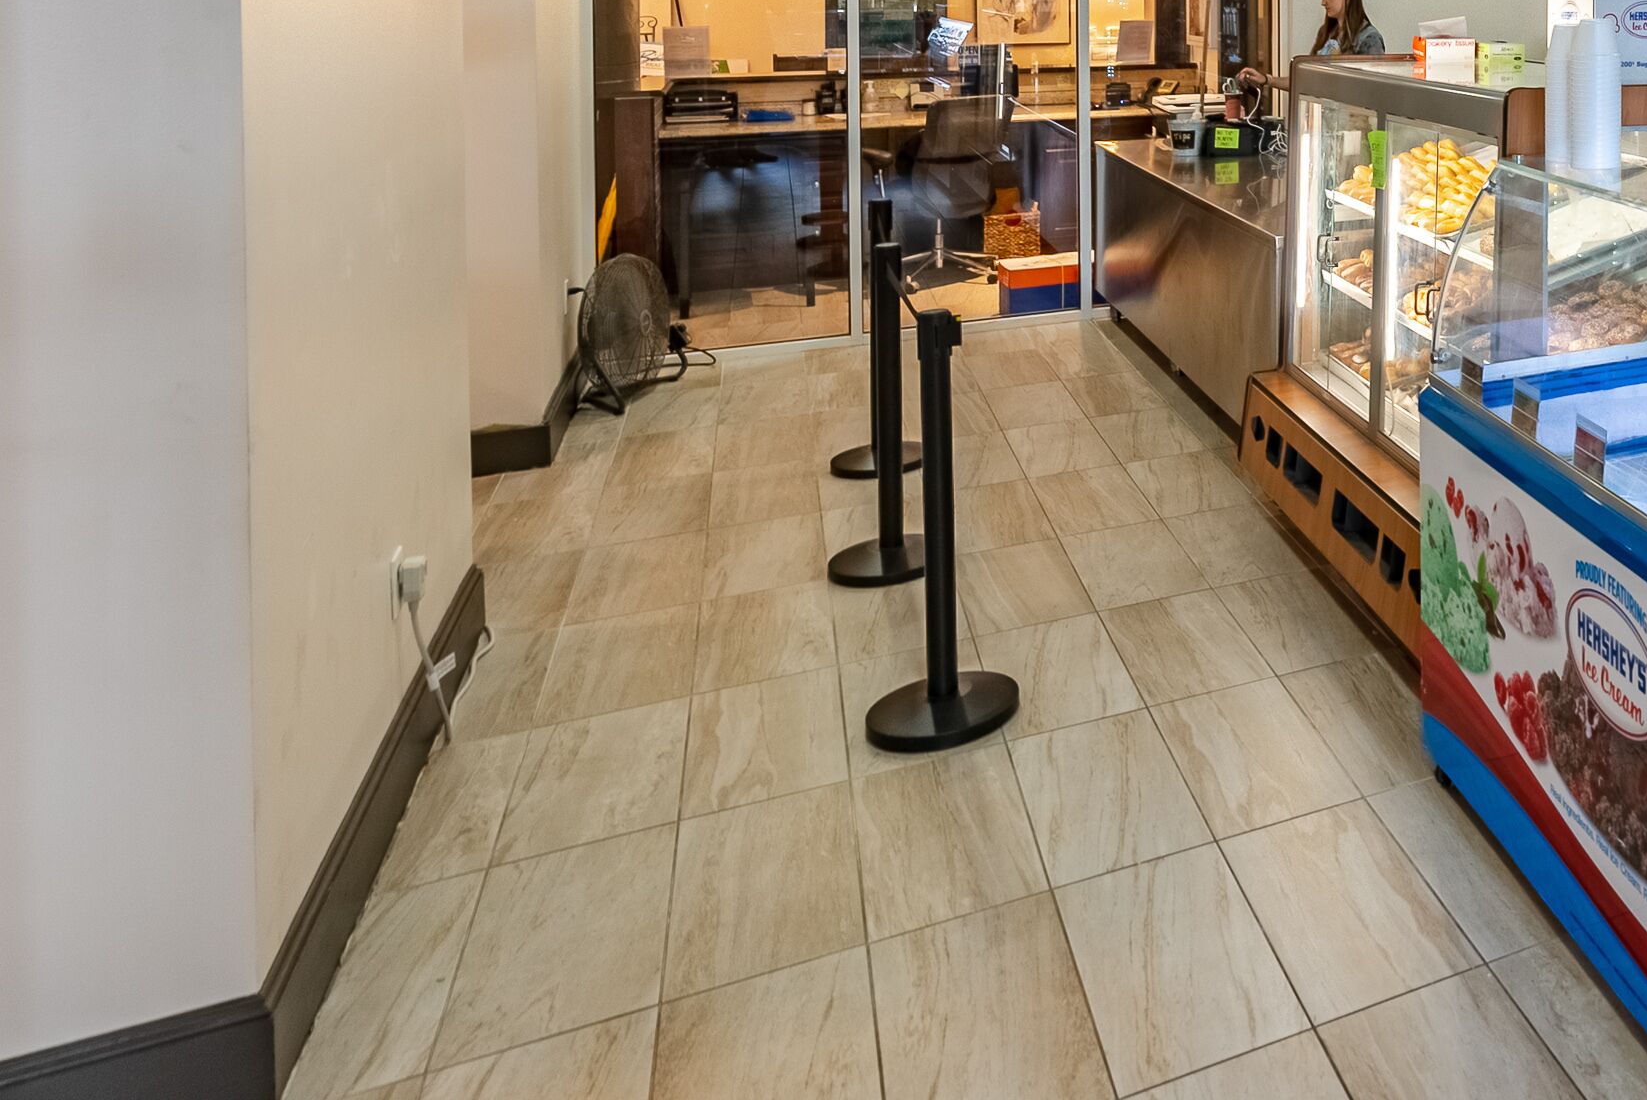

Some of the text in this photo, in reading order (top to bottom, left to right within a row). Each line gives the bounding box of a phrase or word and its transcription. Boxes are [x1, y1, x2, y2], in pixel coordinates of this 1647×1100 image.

[1632, 22, 1642, 31] Ice
[1576, 559, 1647, 634] PROUDLY FEATURING
[1577, 607, 1647, 695] HERSHEY'S
[1582, 644, 1645, 726] Ice Cream
[1550, 783, 1562, 804] Real
[1596, 834, 1609, 857] Real
[1609, 851, 1619, 868] Ice
